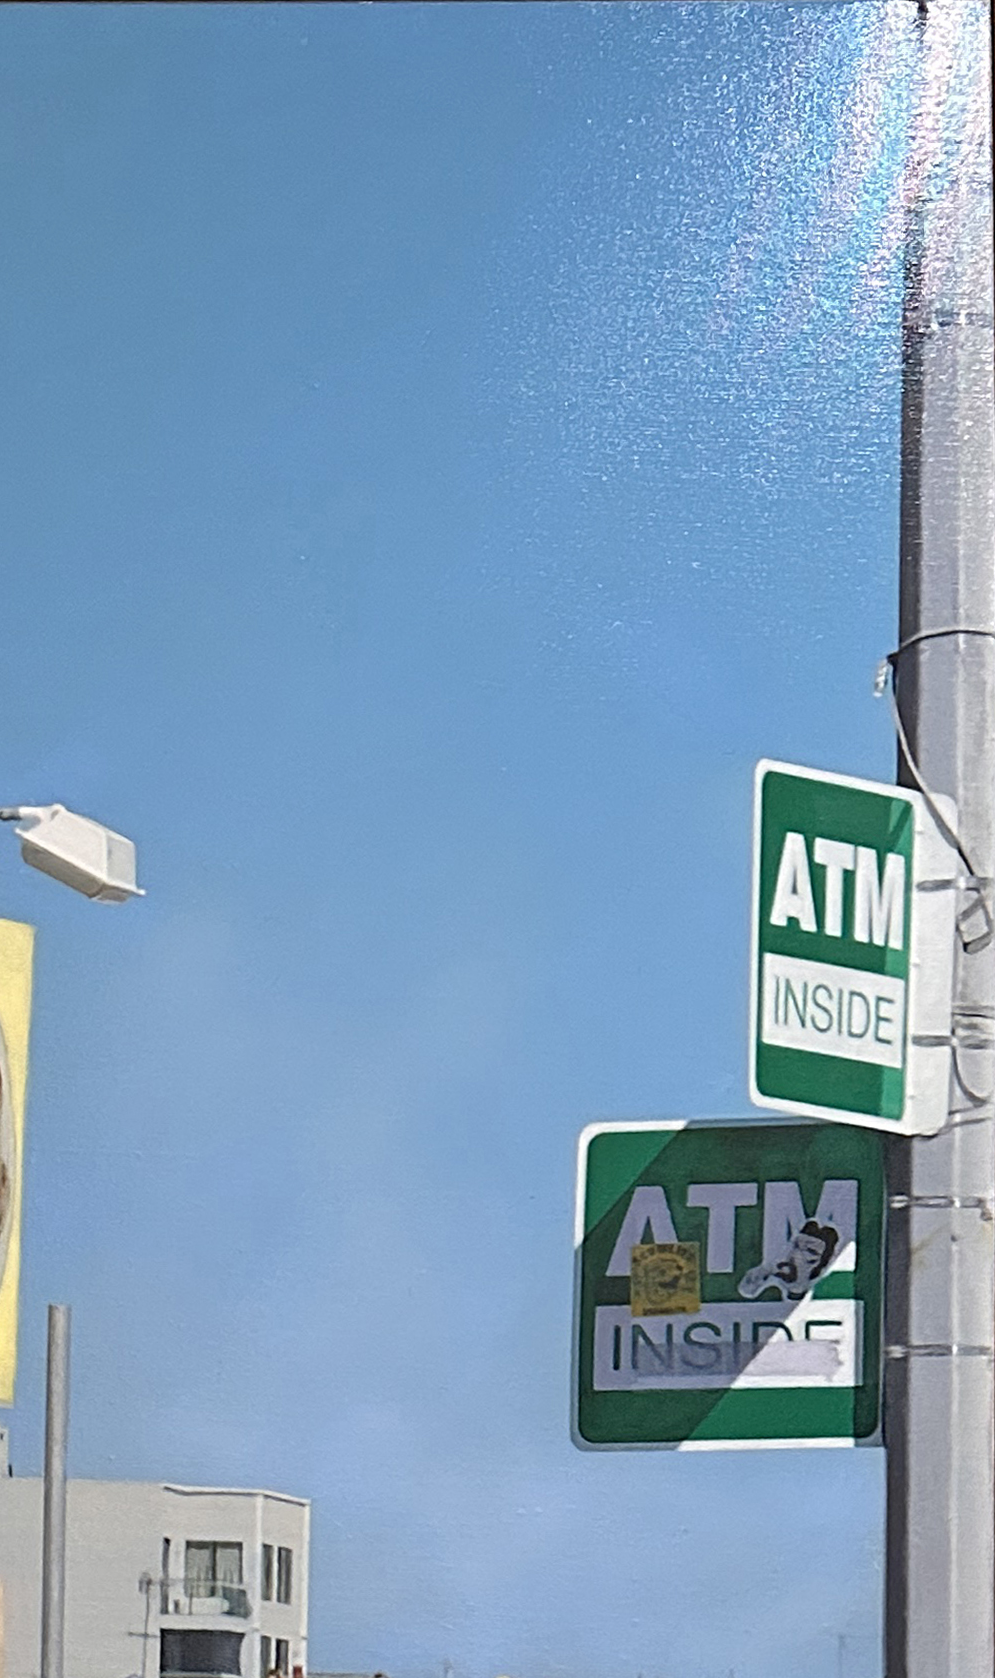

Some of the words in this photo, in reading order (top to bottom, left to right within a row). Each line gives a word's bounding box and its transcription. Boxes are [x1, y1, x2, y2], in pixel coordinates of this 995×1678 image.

[769, 831, 905, 951] ATM
[774, 974, 896, 1046] INSIDE
[605, 1179, 859, 1277] ATM
